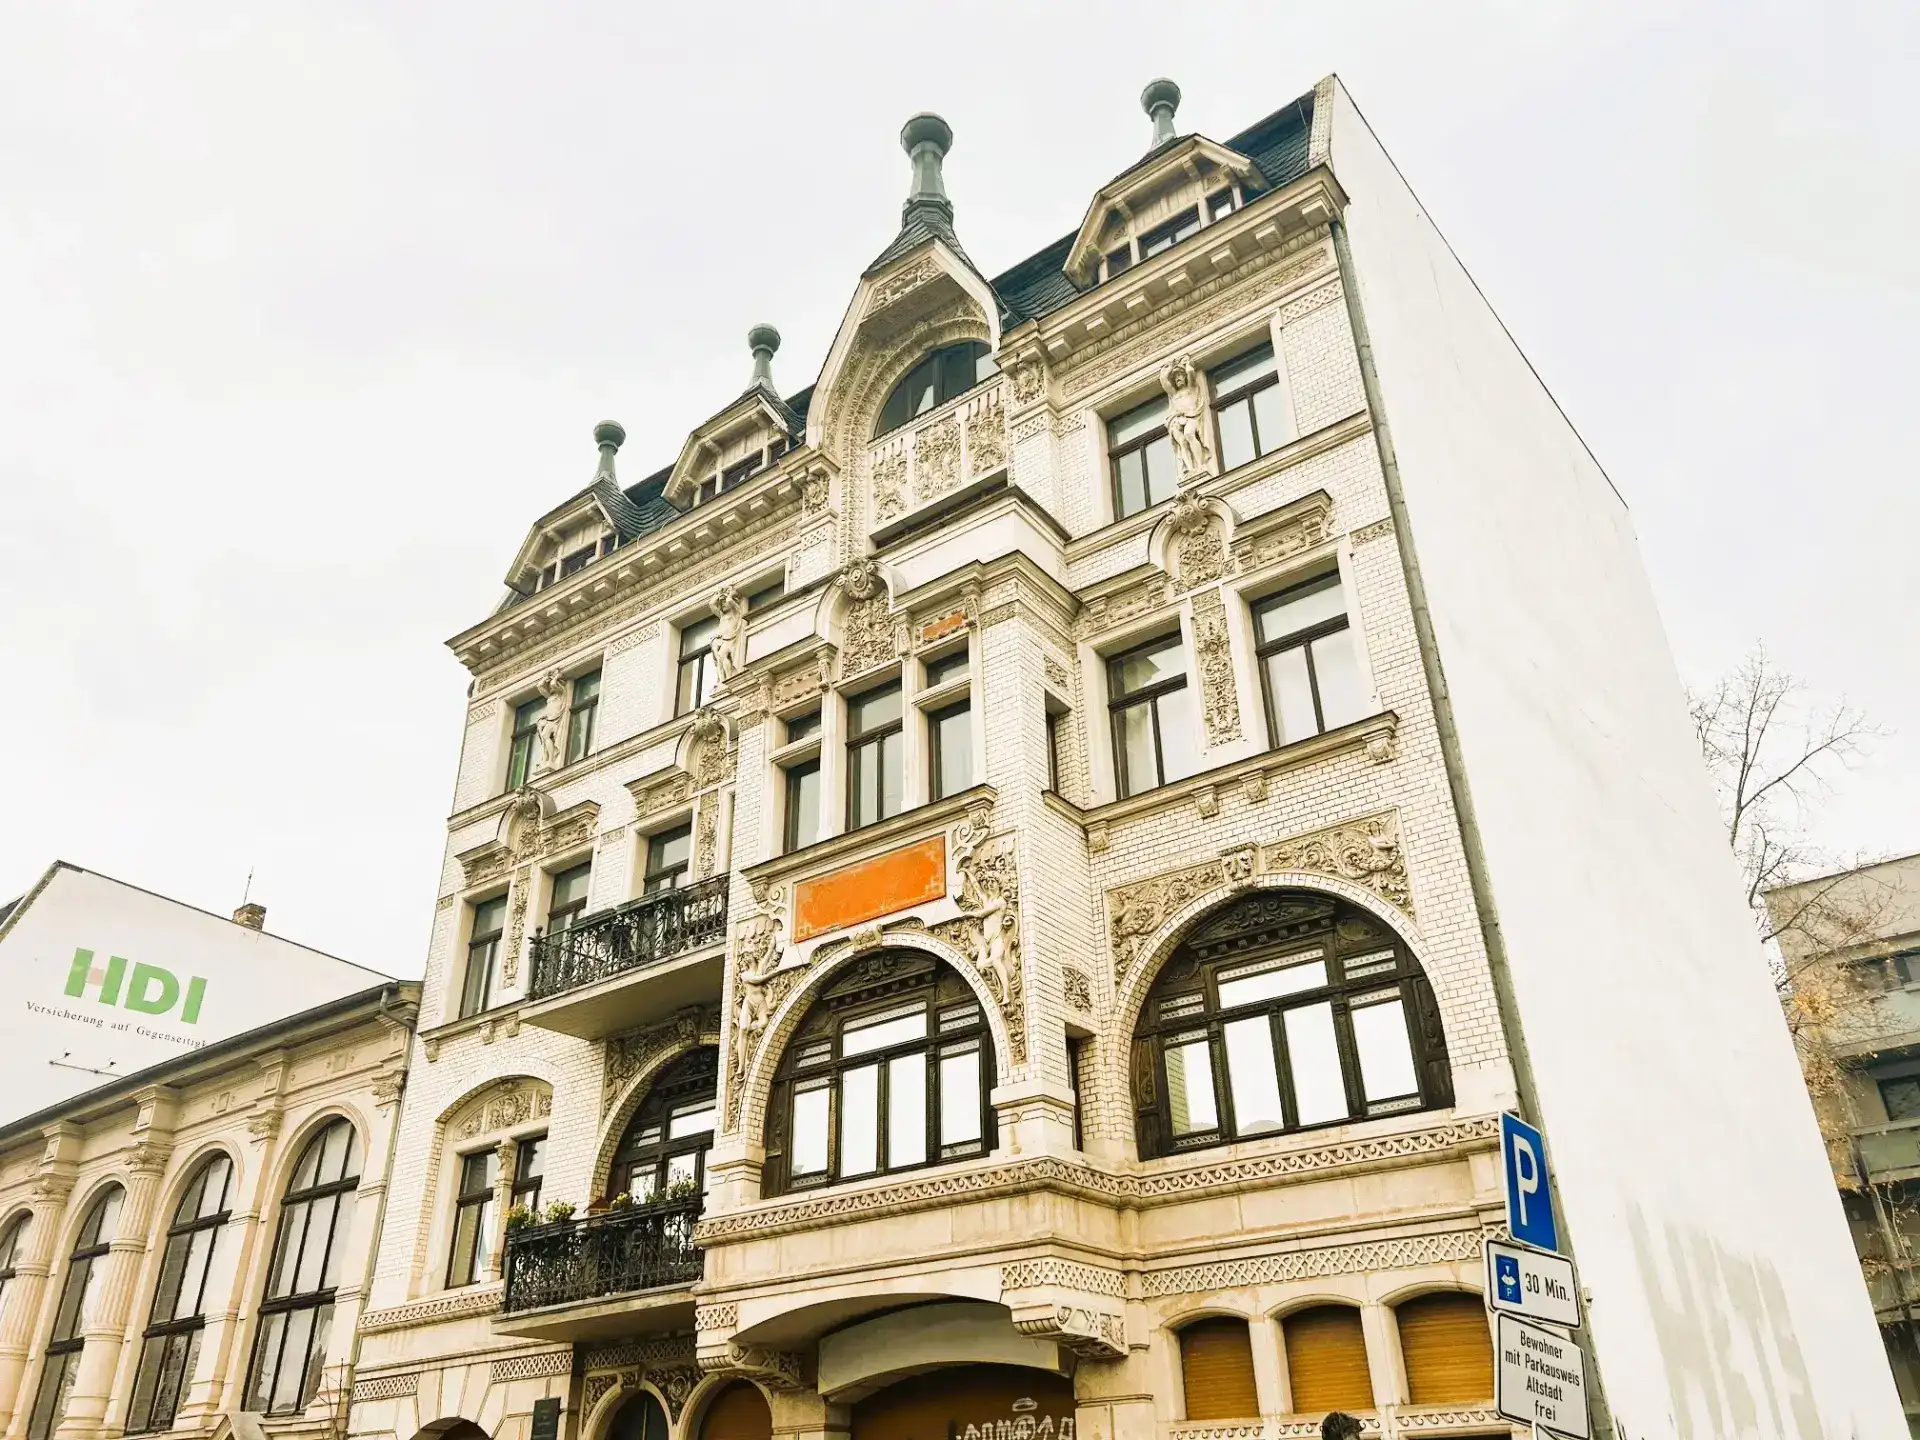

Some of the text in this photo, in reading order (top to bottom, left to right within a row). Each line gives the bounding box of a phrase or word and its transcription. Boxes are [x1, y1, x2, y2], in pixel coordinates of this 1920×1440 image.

[64, 947, 208, 1025] HDI
[26, 1001, 104, 1028] Versicherung
[110, 1022, 131, 1032] auf
[1513, 1133, 1539, 1226] P
[1506, 1287, 1513, 1297] P
[1525, 1272, 1571, 1302] 30 Min.
[1520, 1330, 1563, 1360] Bewohner
[1505, 1349, 1580, 1387] mit Parkausweis
[1526, 1376, 1563, 1402] Altstadt
[1534, 1400, 1556, 1422] frei
